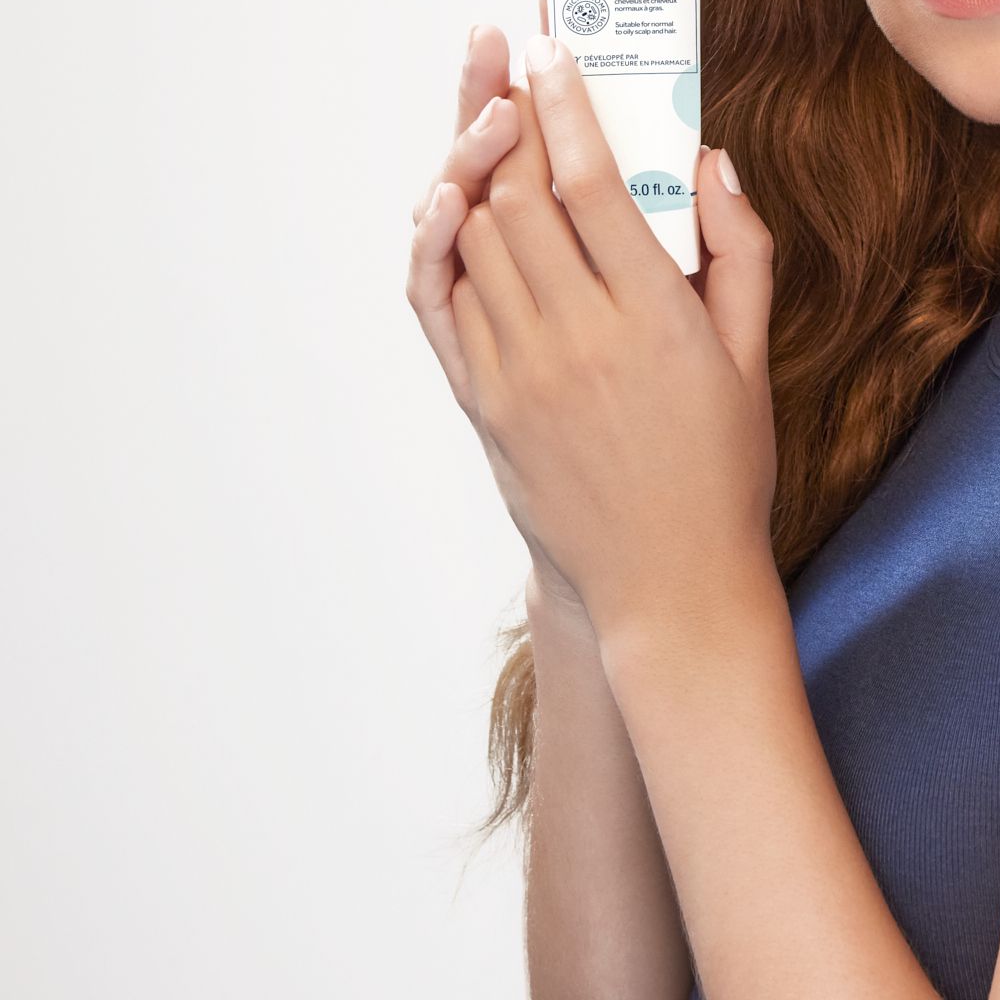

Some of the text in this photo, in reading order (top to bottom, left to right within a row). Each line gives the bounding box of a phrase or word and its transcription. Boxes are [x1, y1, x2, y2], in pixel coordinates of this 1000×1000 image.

[565, 16, 607, 33] INNOVATION
[584, 53, 624, 61] DÉVELOPPÉ
[630, 183, 685, 196] 5.0 fl. oz.
